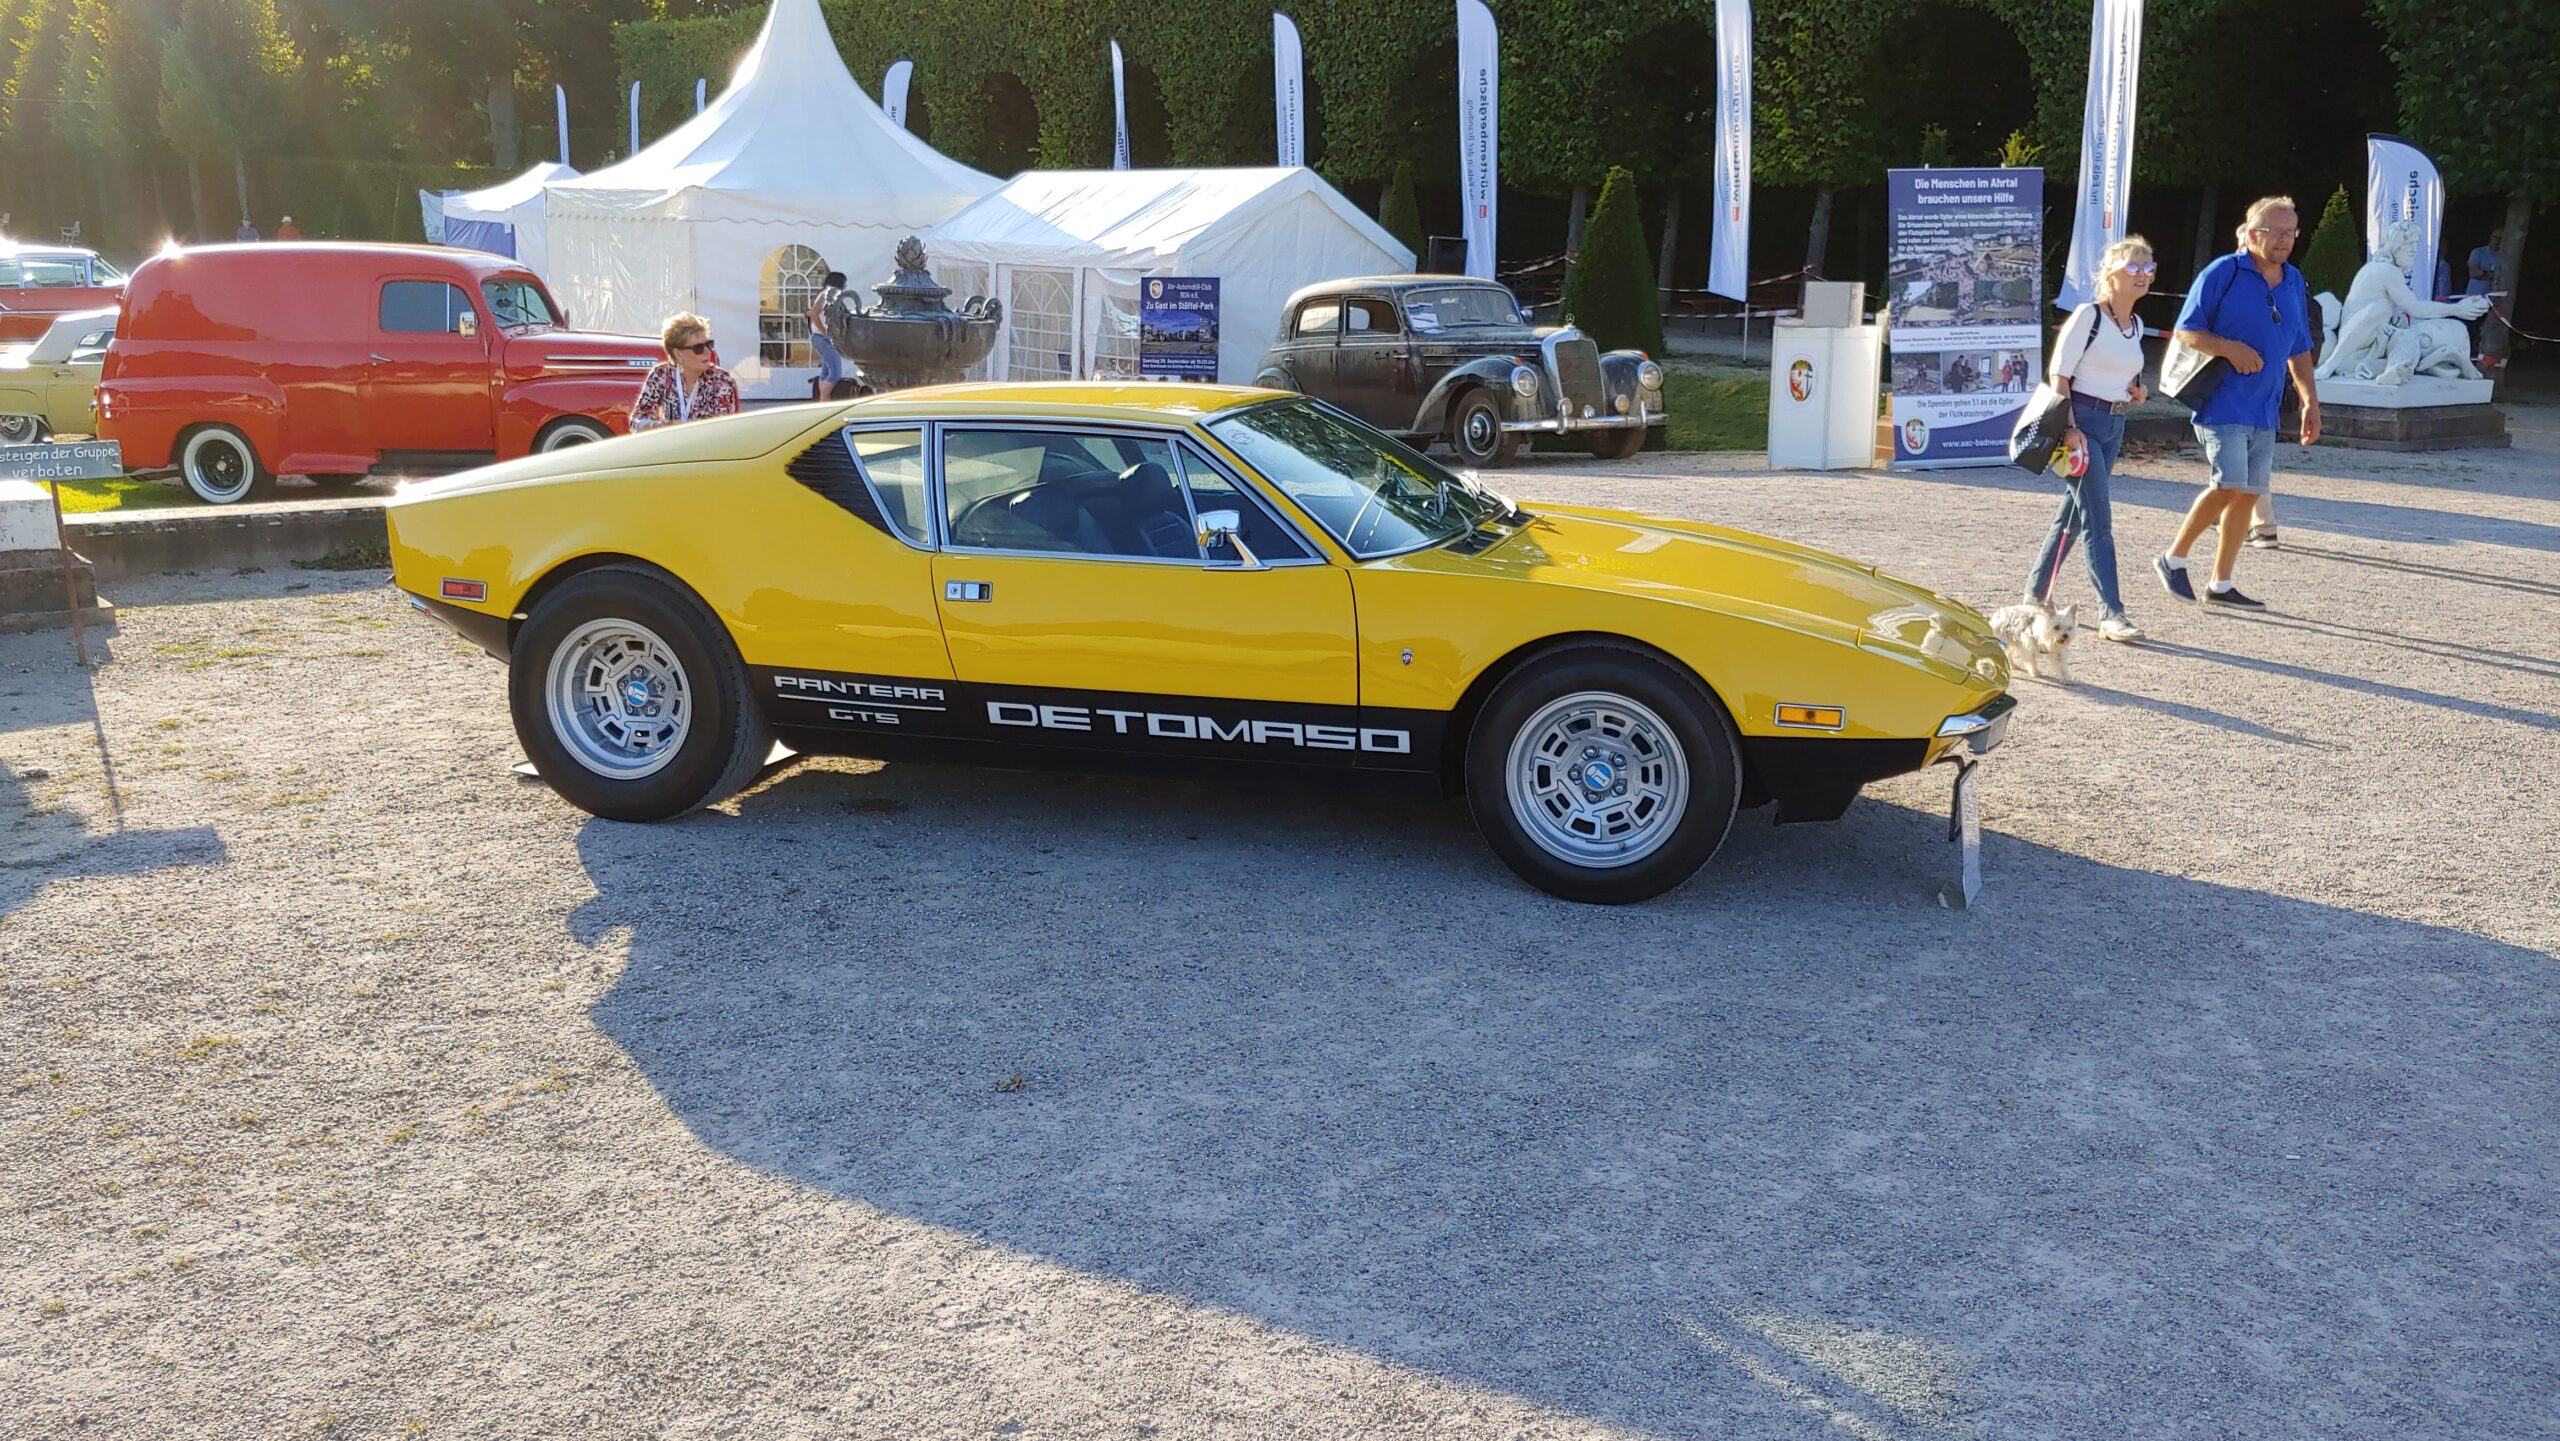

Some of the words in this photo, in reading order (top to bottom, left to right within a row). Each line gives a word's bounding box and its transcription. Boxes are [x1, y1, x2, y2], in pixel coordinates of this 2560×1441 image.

[1915, 178, 1929, 189] Die
[1931, 178, 1976, 189] Menschen
[1977, 178, 1988, 188] im
[1991, 177, 2018, 188] Ahrtal
[1918, 194, 1960, 204] brauchen
[1961, 195, 1992, 203] unsere
[1994, 193, 2014, 203] Hilfe
[1178, 302, 1214, 310] Stöffel-Park
[1917, 400, 1926, 409] Die
[1928, 399, 1953, 409] Spenden
[1954, 399, 1972, 409] gehen
[1989, 398, 1997, 406] die
[1998, 397, 2014, 407] Opfer
[1938, 411, 1948, 419] der
[1949, 410, 1994, 419] Flutkatastrophe
[51, 447, 71, 460] der
[12, 464, 83, 479] verboten
[773, 675, 945, 701] PANTERA
[828, 708, 900, 725] GTS
